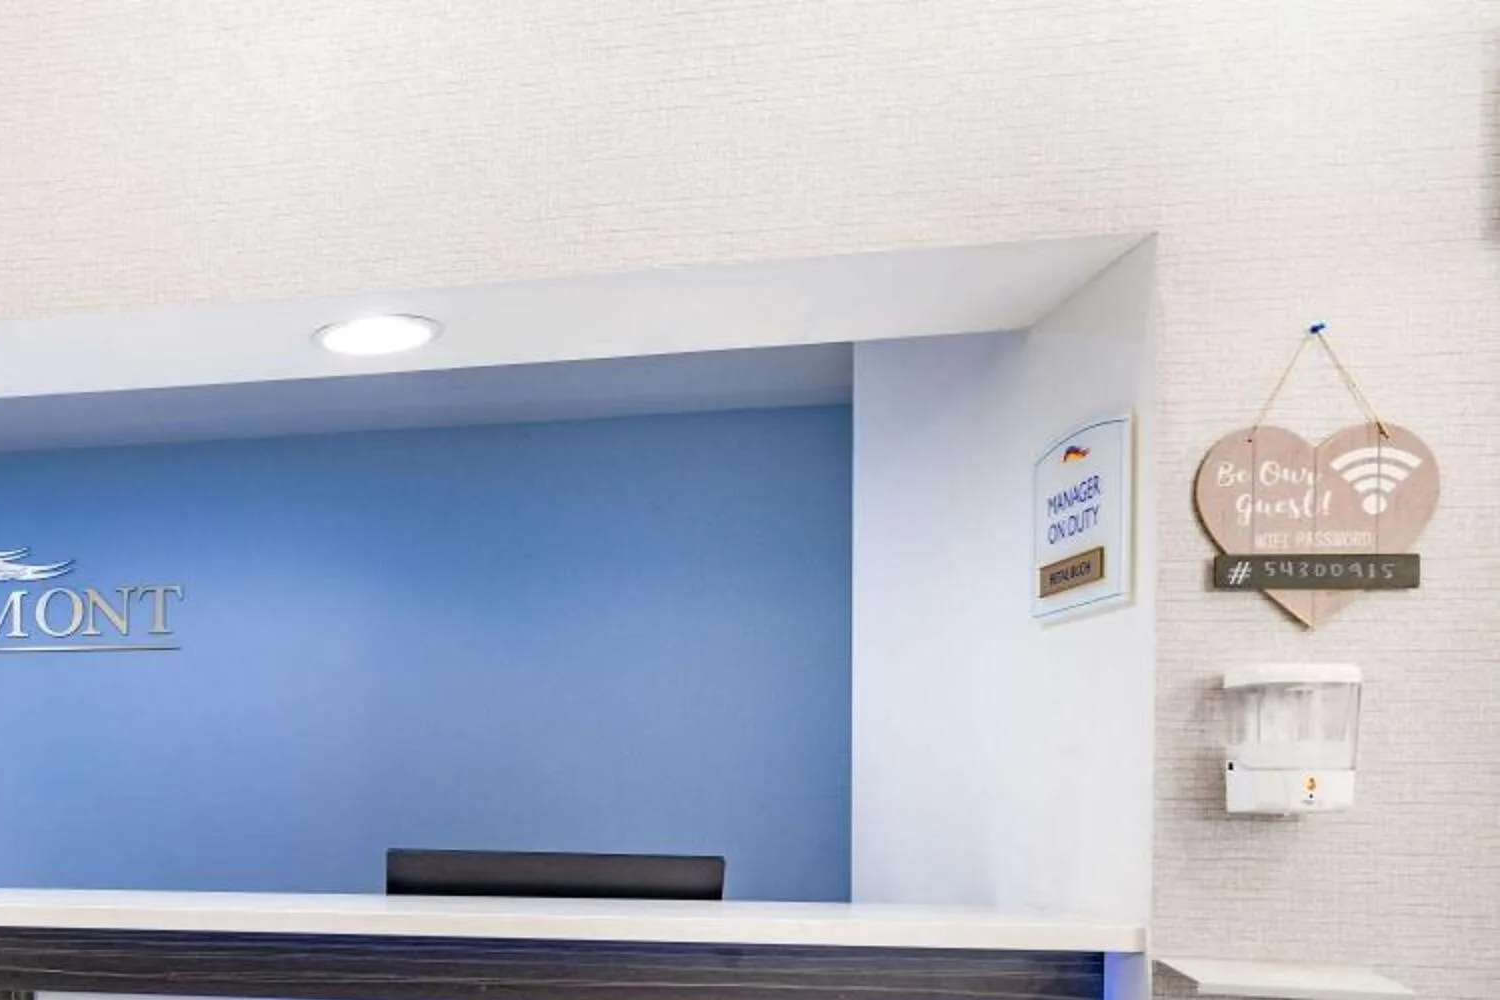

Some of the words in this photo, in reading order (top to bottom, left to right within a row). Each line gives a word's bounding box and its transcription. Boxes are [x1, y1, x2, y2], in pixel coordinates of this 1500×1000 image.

[1216, 461, 1247, 487] Be
[1259, 461, 1321, 487] Our
[1046, 475, 1102, 517] MANAGER
[1047, 522, 1066, 545] ON
[1067, 506, 1100, 537] DUTY
